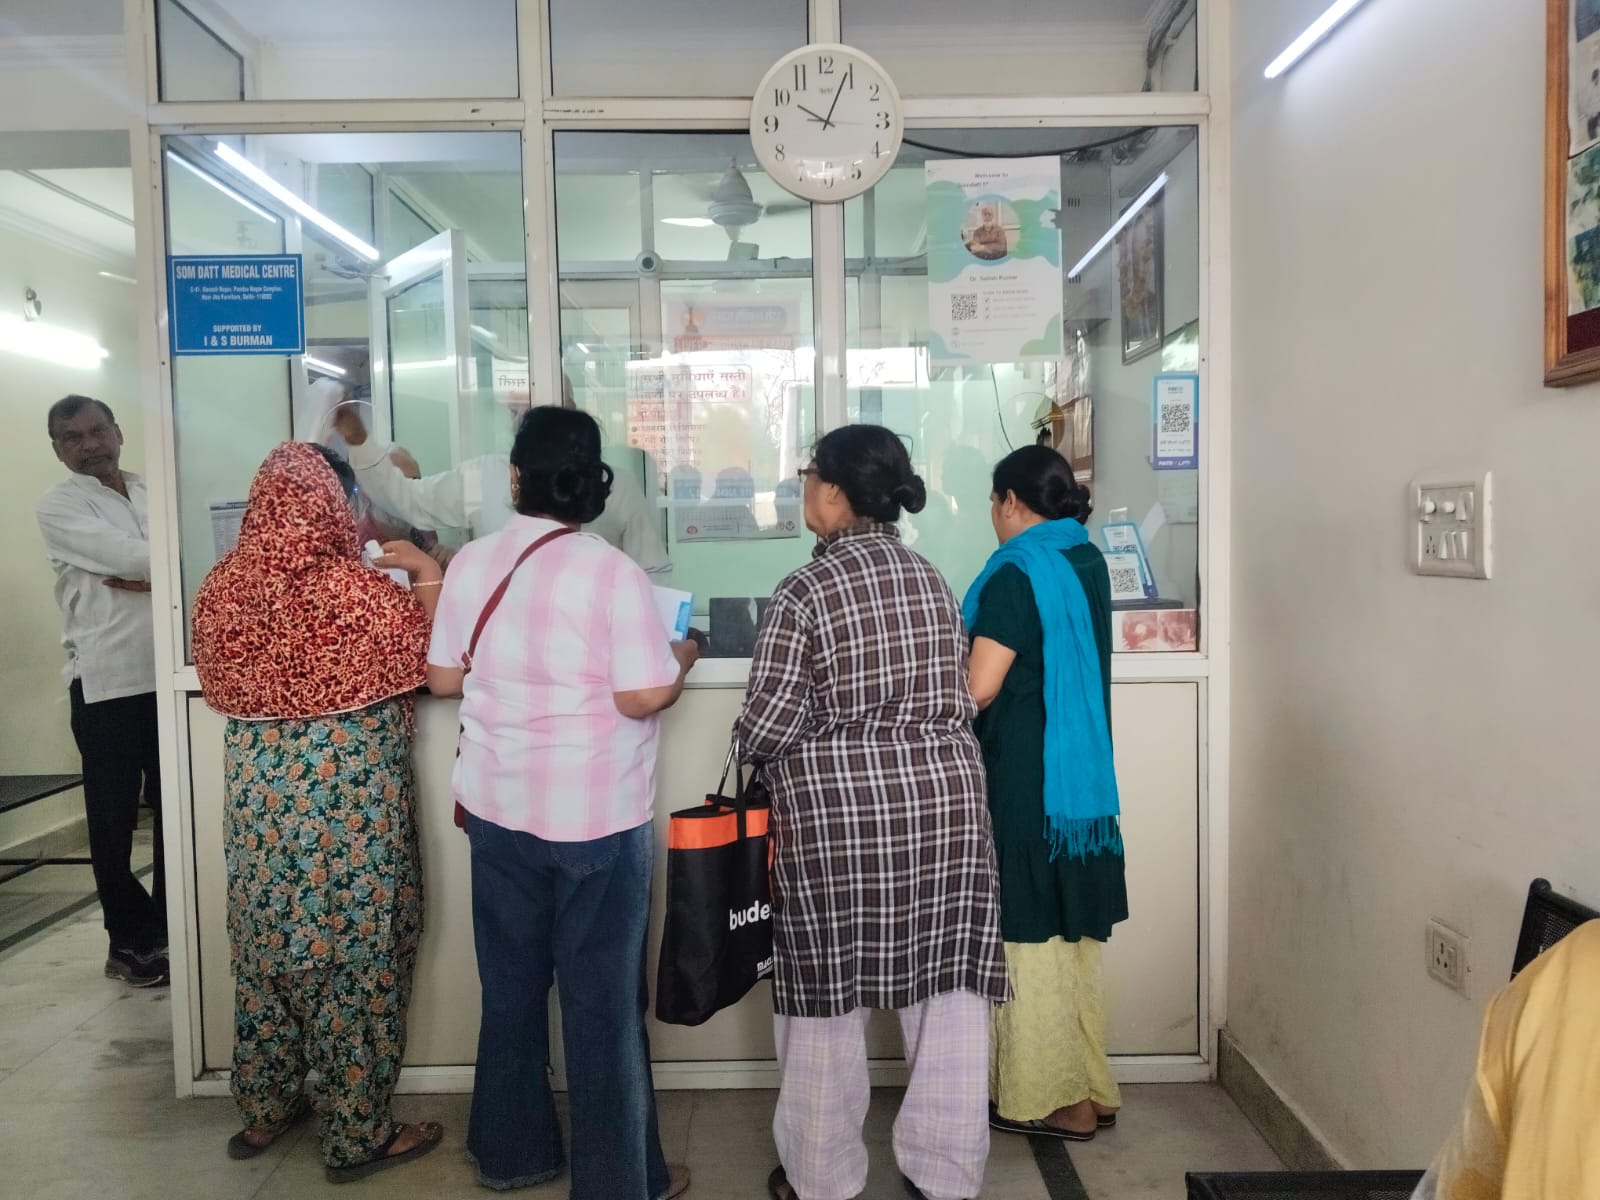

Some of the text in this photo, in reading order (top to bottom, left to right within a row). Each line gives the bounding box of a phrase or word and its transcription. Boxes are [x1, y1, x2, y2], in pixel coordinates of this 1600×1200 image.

[818, 56, 834, 74] 12
[794, 64, 806, 91] 11
[849, 63, 854, 89] 1
[775, 88, 790, 107] 10
[869, 84, 880, 101] 2
[764, 115, 779, 133] 9
[875, 112, 890, 129] 3
[775, 143, 785, 161] 8
[871, 141, 882, 159] 4
[176, 264, 295, 279] SOM DATT MEDICAL CENTRE
[213, 325, 251, 333] SUPPORTED
[210, 336, 218, 346] &
[221, 336, 228, 346] S
[230, 335, 272, 346] BURMAN
[729, 900, 773, 931] bude
